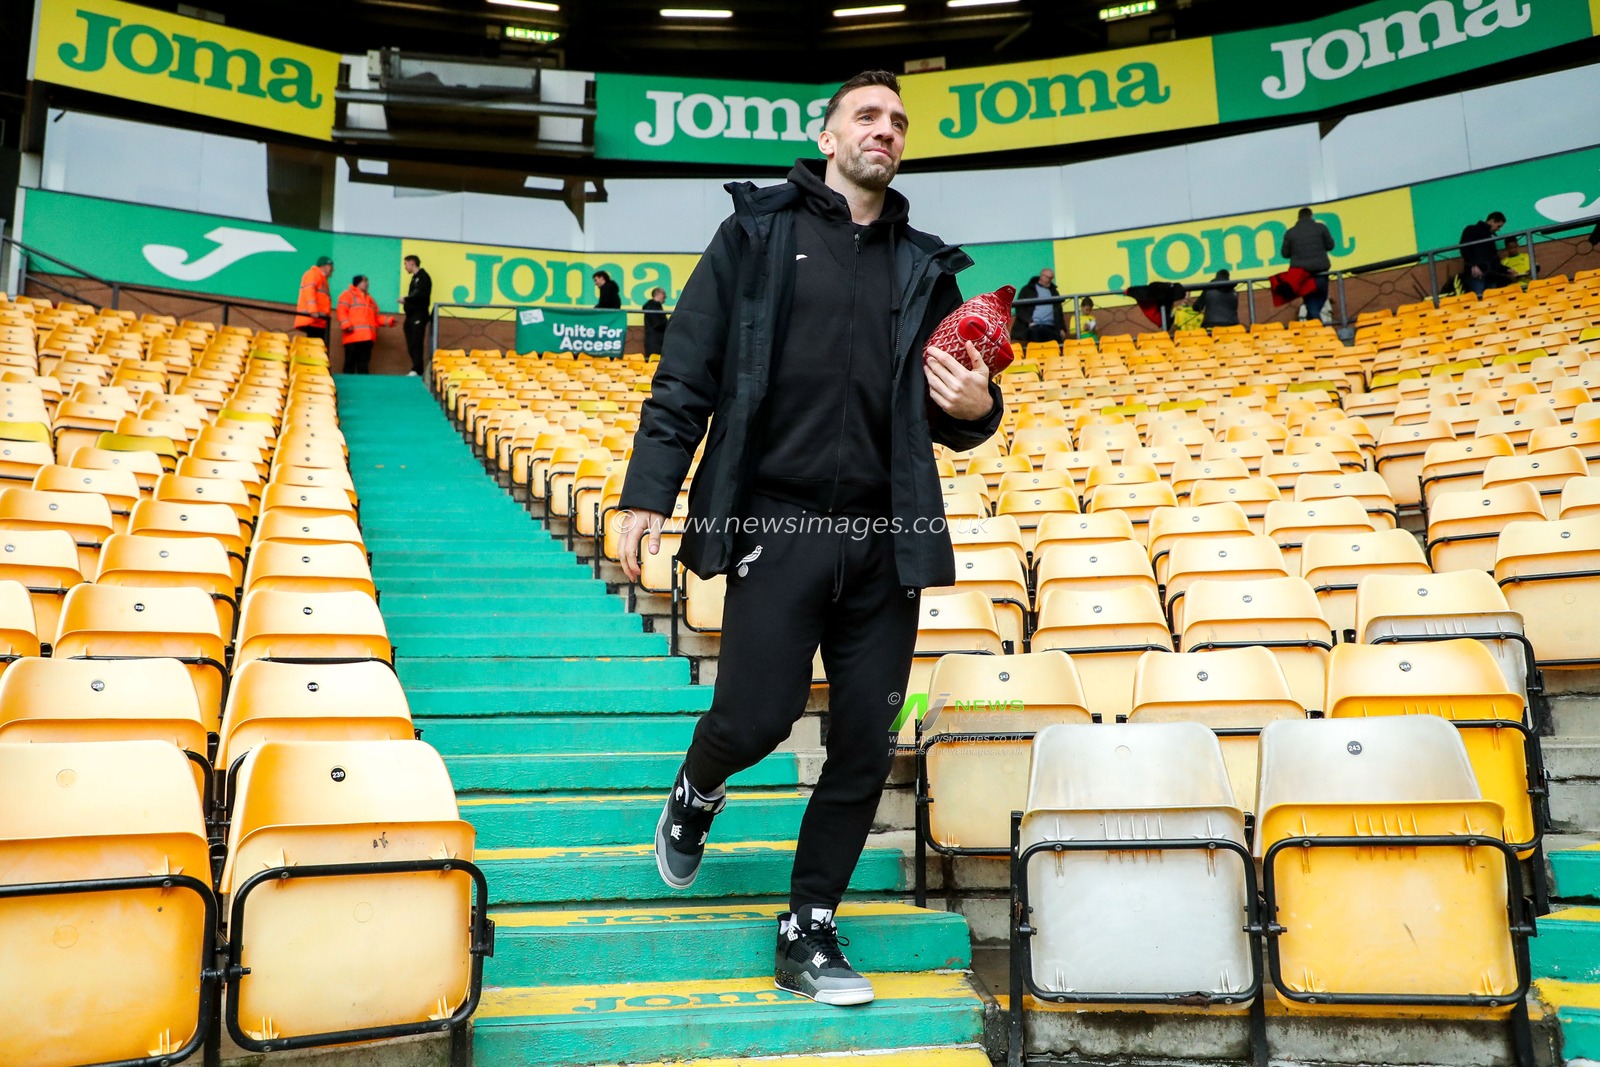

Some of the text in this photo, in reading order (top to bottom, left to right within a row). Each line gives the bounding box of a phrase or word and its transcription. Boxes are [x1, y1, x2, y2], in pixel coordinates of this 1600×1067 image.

[1261, 0, 1530, 100] Joma
[58, 9, 323, 109] Joma
[939, 61, 1170, 139] Joma
[552, 323, 623, 338] Unite For
[559, 337, 622, 351] Access
[1347, 744, 1361, 752] 243
[331, 770, 345, 779] 239
[566, 910, 790, 925] Jom
[571, 989, 808, 1013] Jom
